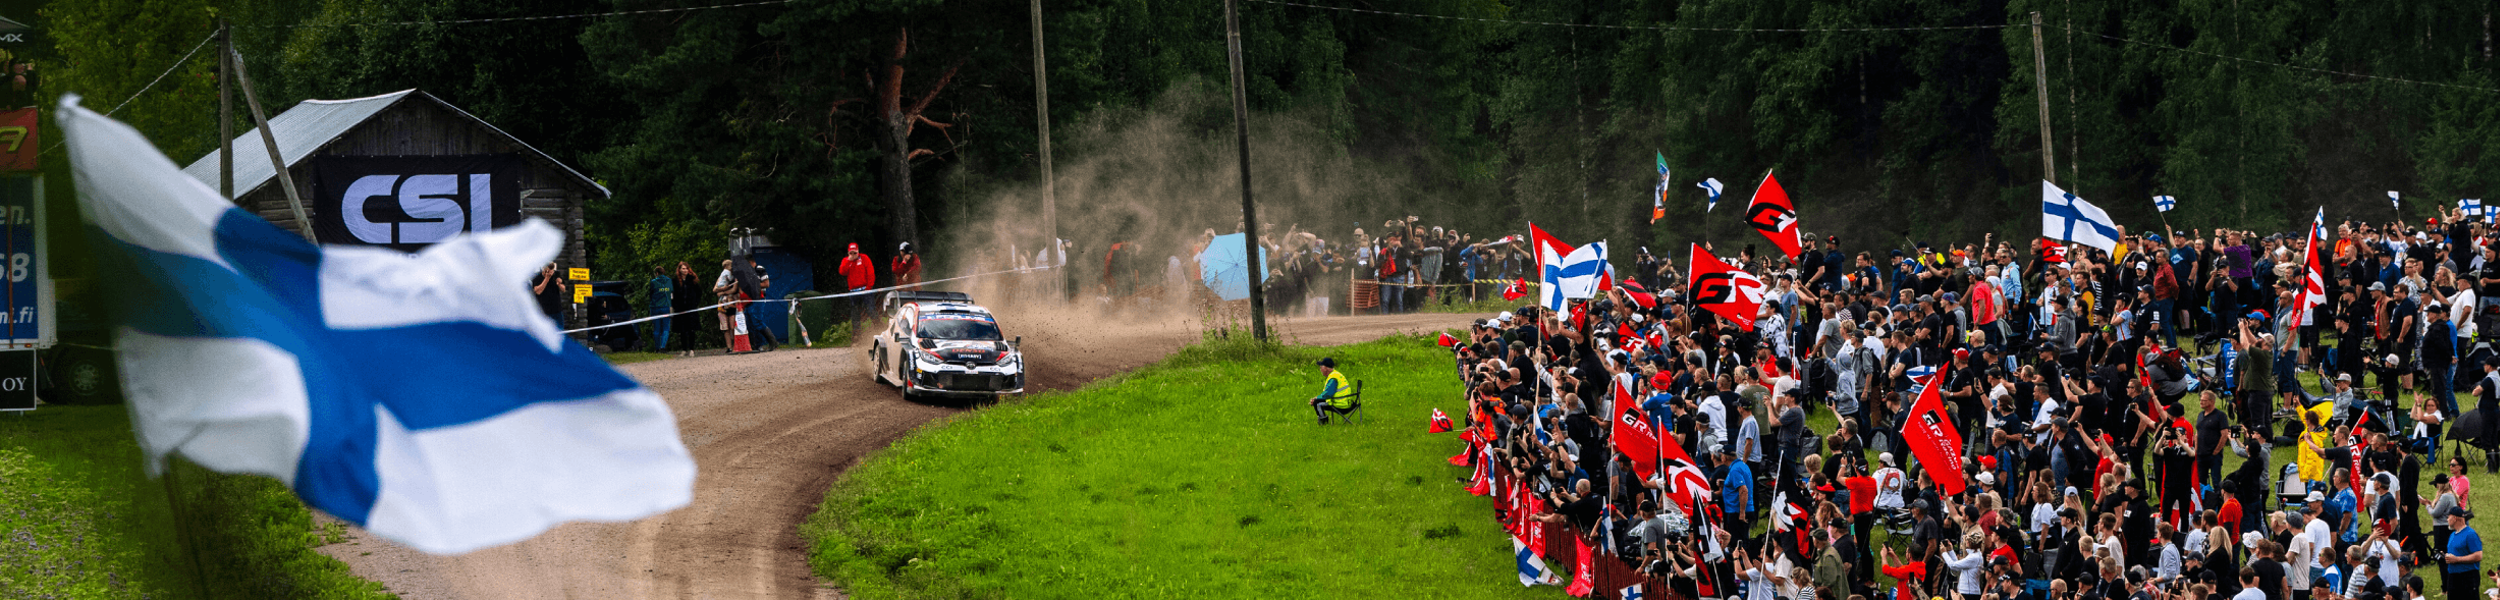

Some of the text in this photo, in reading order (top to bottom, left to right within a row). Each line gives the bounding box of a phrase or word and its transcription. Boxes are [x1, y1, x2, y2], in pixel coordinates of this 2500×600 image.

[341, 173, 492, 244] CSI
[0, 252, 30, 282] 8
[1689, 270, 1768, 304] GR
[2, 377, 27, 391] OY
[1622, 413, 1647, 433] GR
[2348, 435, 2361, 457] GR
